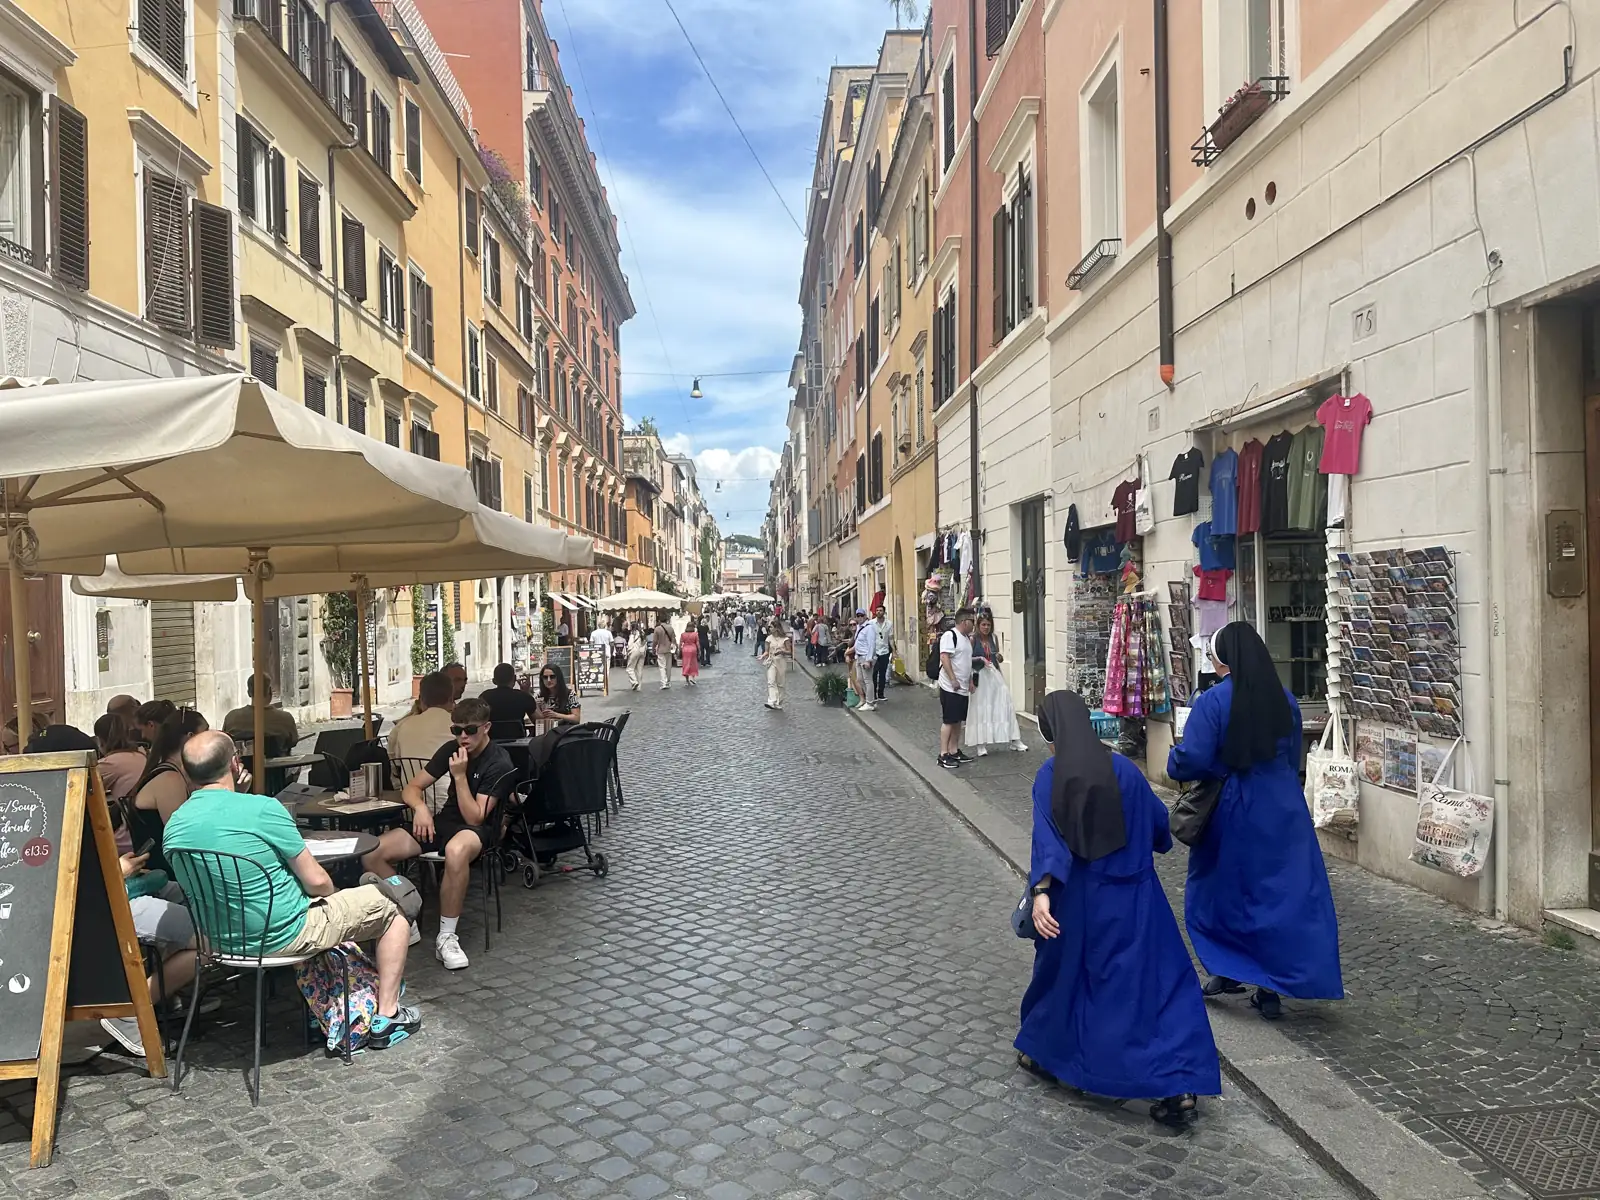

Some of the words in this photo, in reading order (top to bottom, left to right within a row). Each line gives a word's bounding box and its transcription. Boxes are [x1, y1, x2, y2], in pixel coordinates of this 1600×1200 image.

[1355, 310, 1372, 337] 75
[1094, 545, 1115, 556] ITLIA
[1329, 765, 1354, 774] ROMA
[1430, 791, 1465, 808] Roma
[1, 819, 32, 833] drink
[24, 845, 49, 857] €13.5
